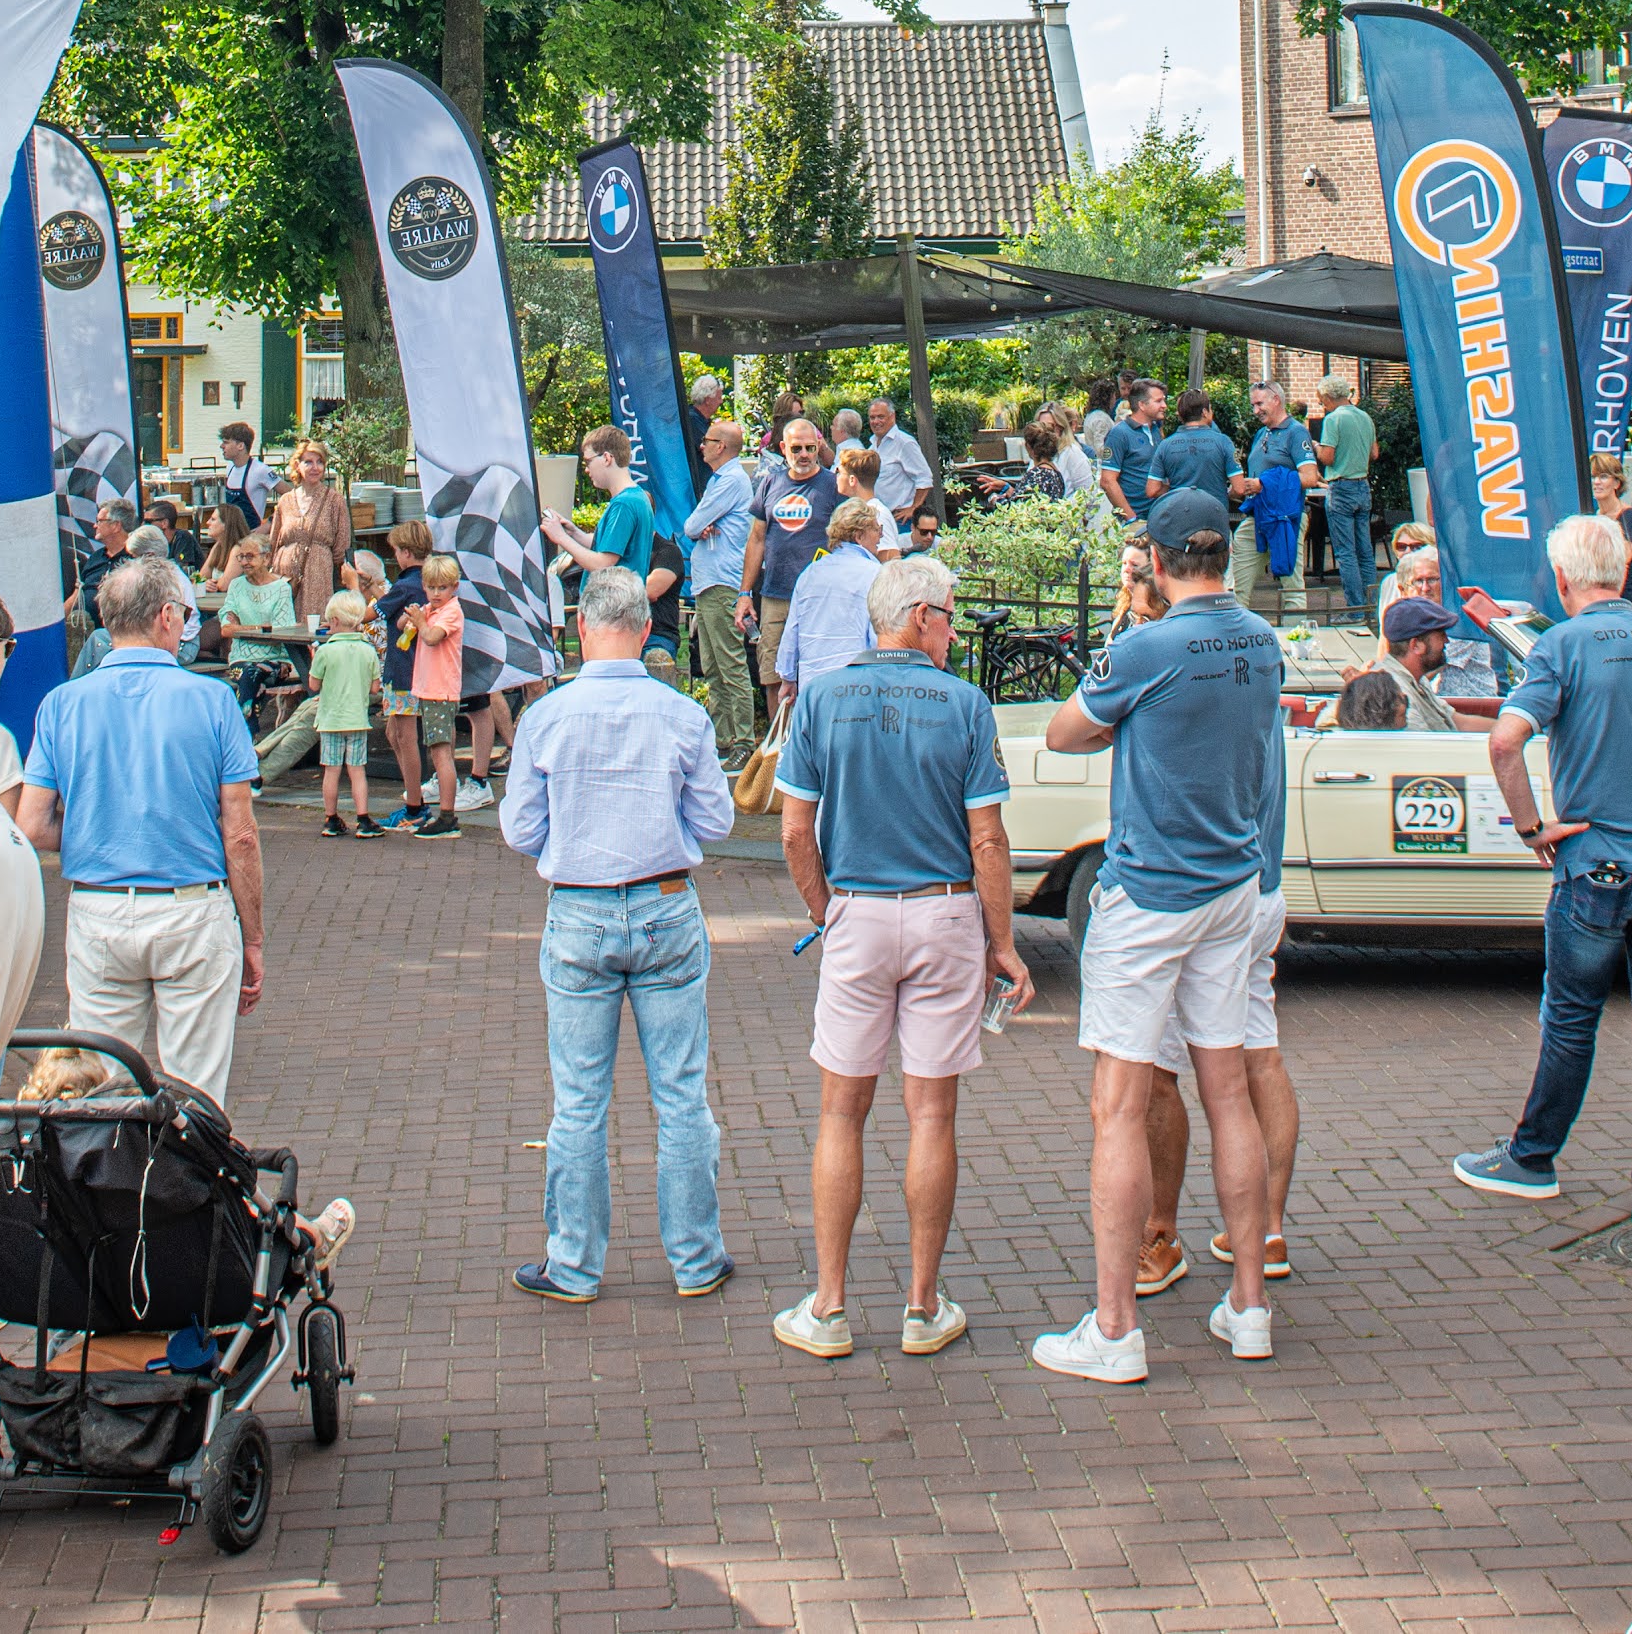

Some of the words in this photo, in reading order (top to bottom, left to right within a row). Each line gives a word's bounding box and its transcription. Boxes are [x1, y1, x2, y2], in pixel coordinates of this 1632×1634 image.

[1563, 255, 1599, 267] gstraat
[775, 507, 810, 517] Gulf
[1187, 638, 1223, 654] CITO
[1227, 633, 1274, 651] MOTORS
[1190, 672, 1227, 681] McLaren
[832, 684, 872, 698] CITO
[876, 685, 949, 703] MOTORS
[1404, 802, 1455, 828] 229
